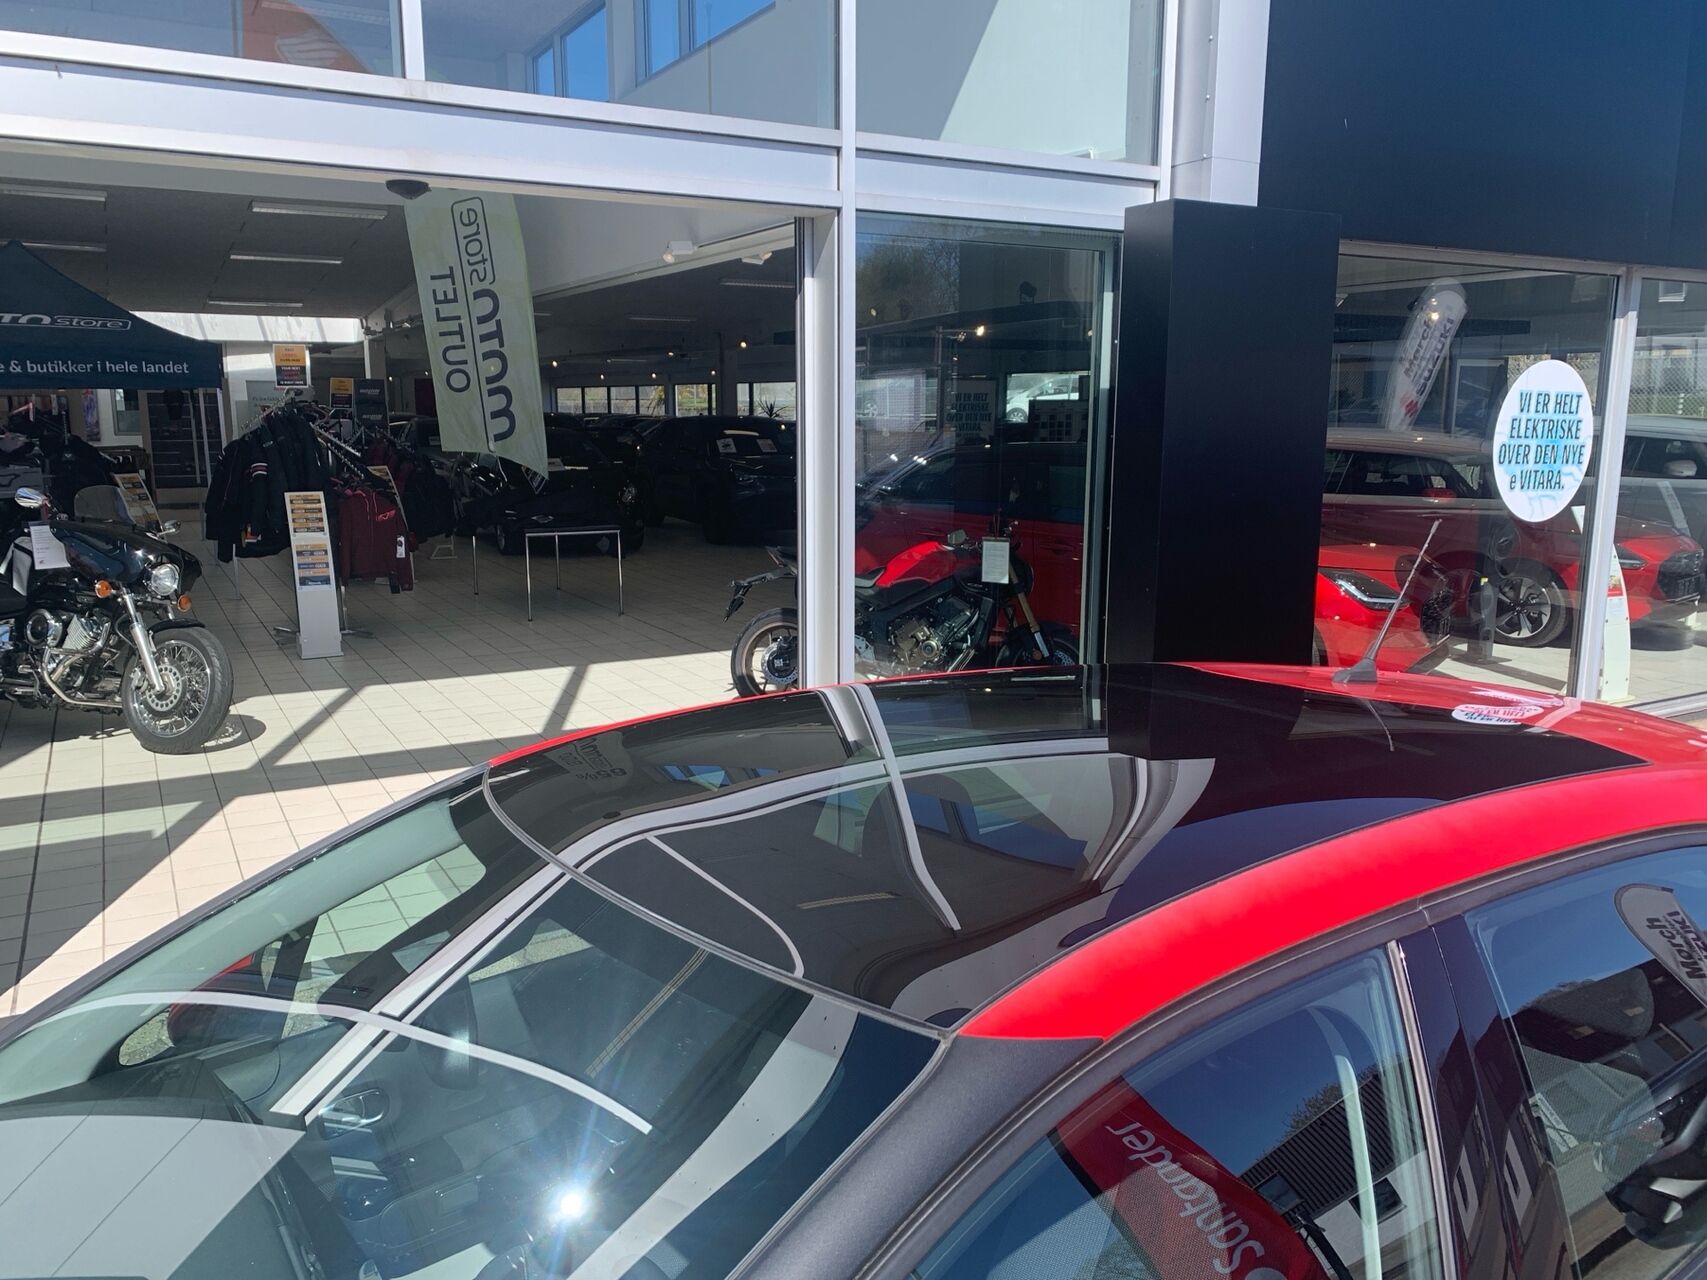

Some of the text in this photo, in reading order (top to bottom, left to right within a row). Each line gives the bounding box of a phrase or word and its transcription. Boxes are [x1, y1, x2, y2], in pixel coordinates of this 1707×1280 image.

[55, 317, 122, 328] store
[9, 361, 22, 373] &
[27, 360, 93, 373] butikker
[97, 361, 101, 373] i
[106, 361, 138, 373] hele
[142, 361, 189, 373] landet
[1519, 391, 1582, 415] VI ER HELT
[1509, 417, 1583, 440] ELEKTRISKE
[1498, 443, 1585, 465] OVER DEN NYE
[1509, 469, 1564, 490] e VITARA.
[1105, 1121, 1265, 1275] Santander
